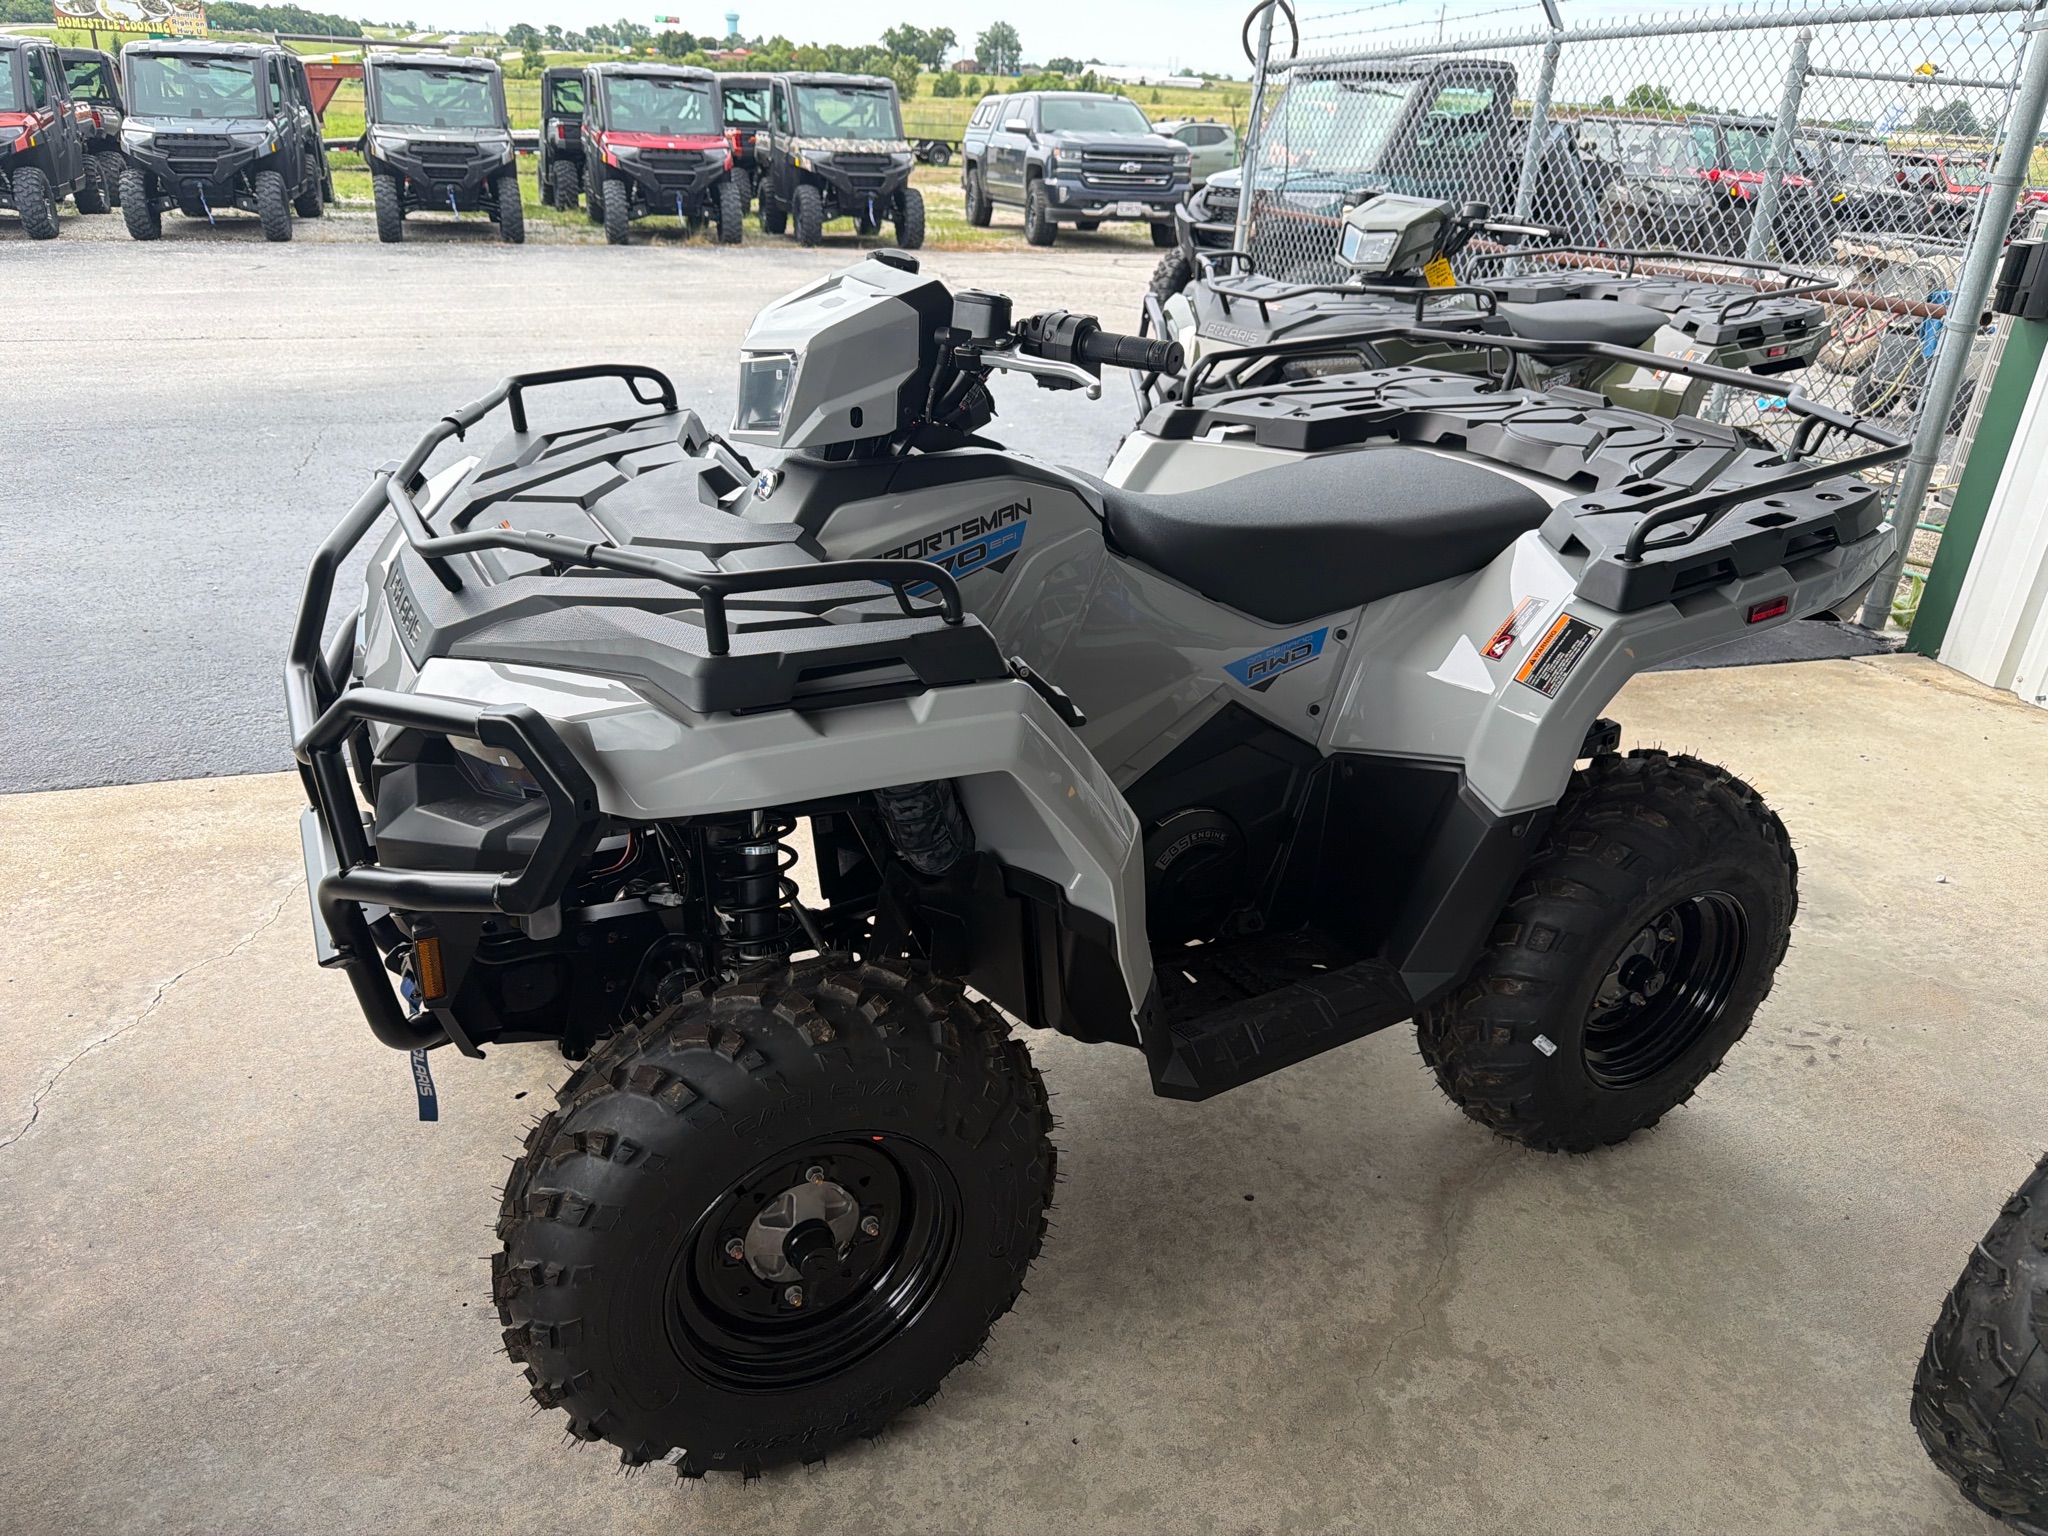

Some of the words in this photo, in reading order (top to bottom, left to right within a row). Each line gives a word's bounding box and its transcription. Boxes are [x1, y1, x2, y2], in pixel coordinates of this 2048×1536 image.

[56, 16, 121, 31] HOMESTYLE
[123, 20, 171, 34] COOKING
[171, 19, 193, 27] Right
[177, 27, 194, 35] Hwy
[1206, 322, 1259, 343] POLARIS
[872, 498, 1032, 560] PORTSMAN
[990, 532, 1017, 550] EFI
[1535, 630, 1557, 658] WARNING
[1247, 643, 1313, 680] AWD
[1158, 837, 1189, 866] EBS
[1191, 830, 1226, 841] ENGINE
